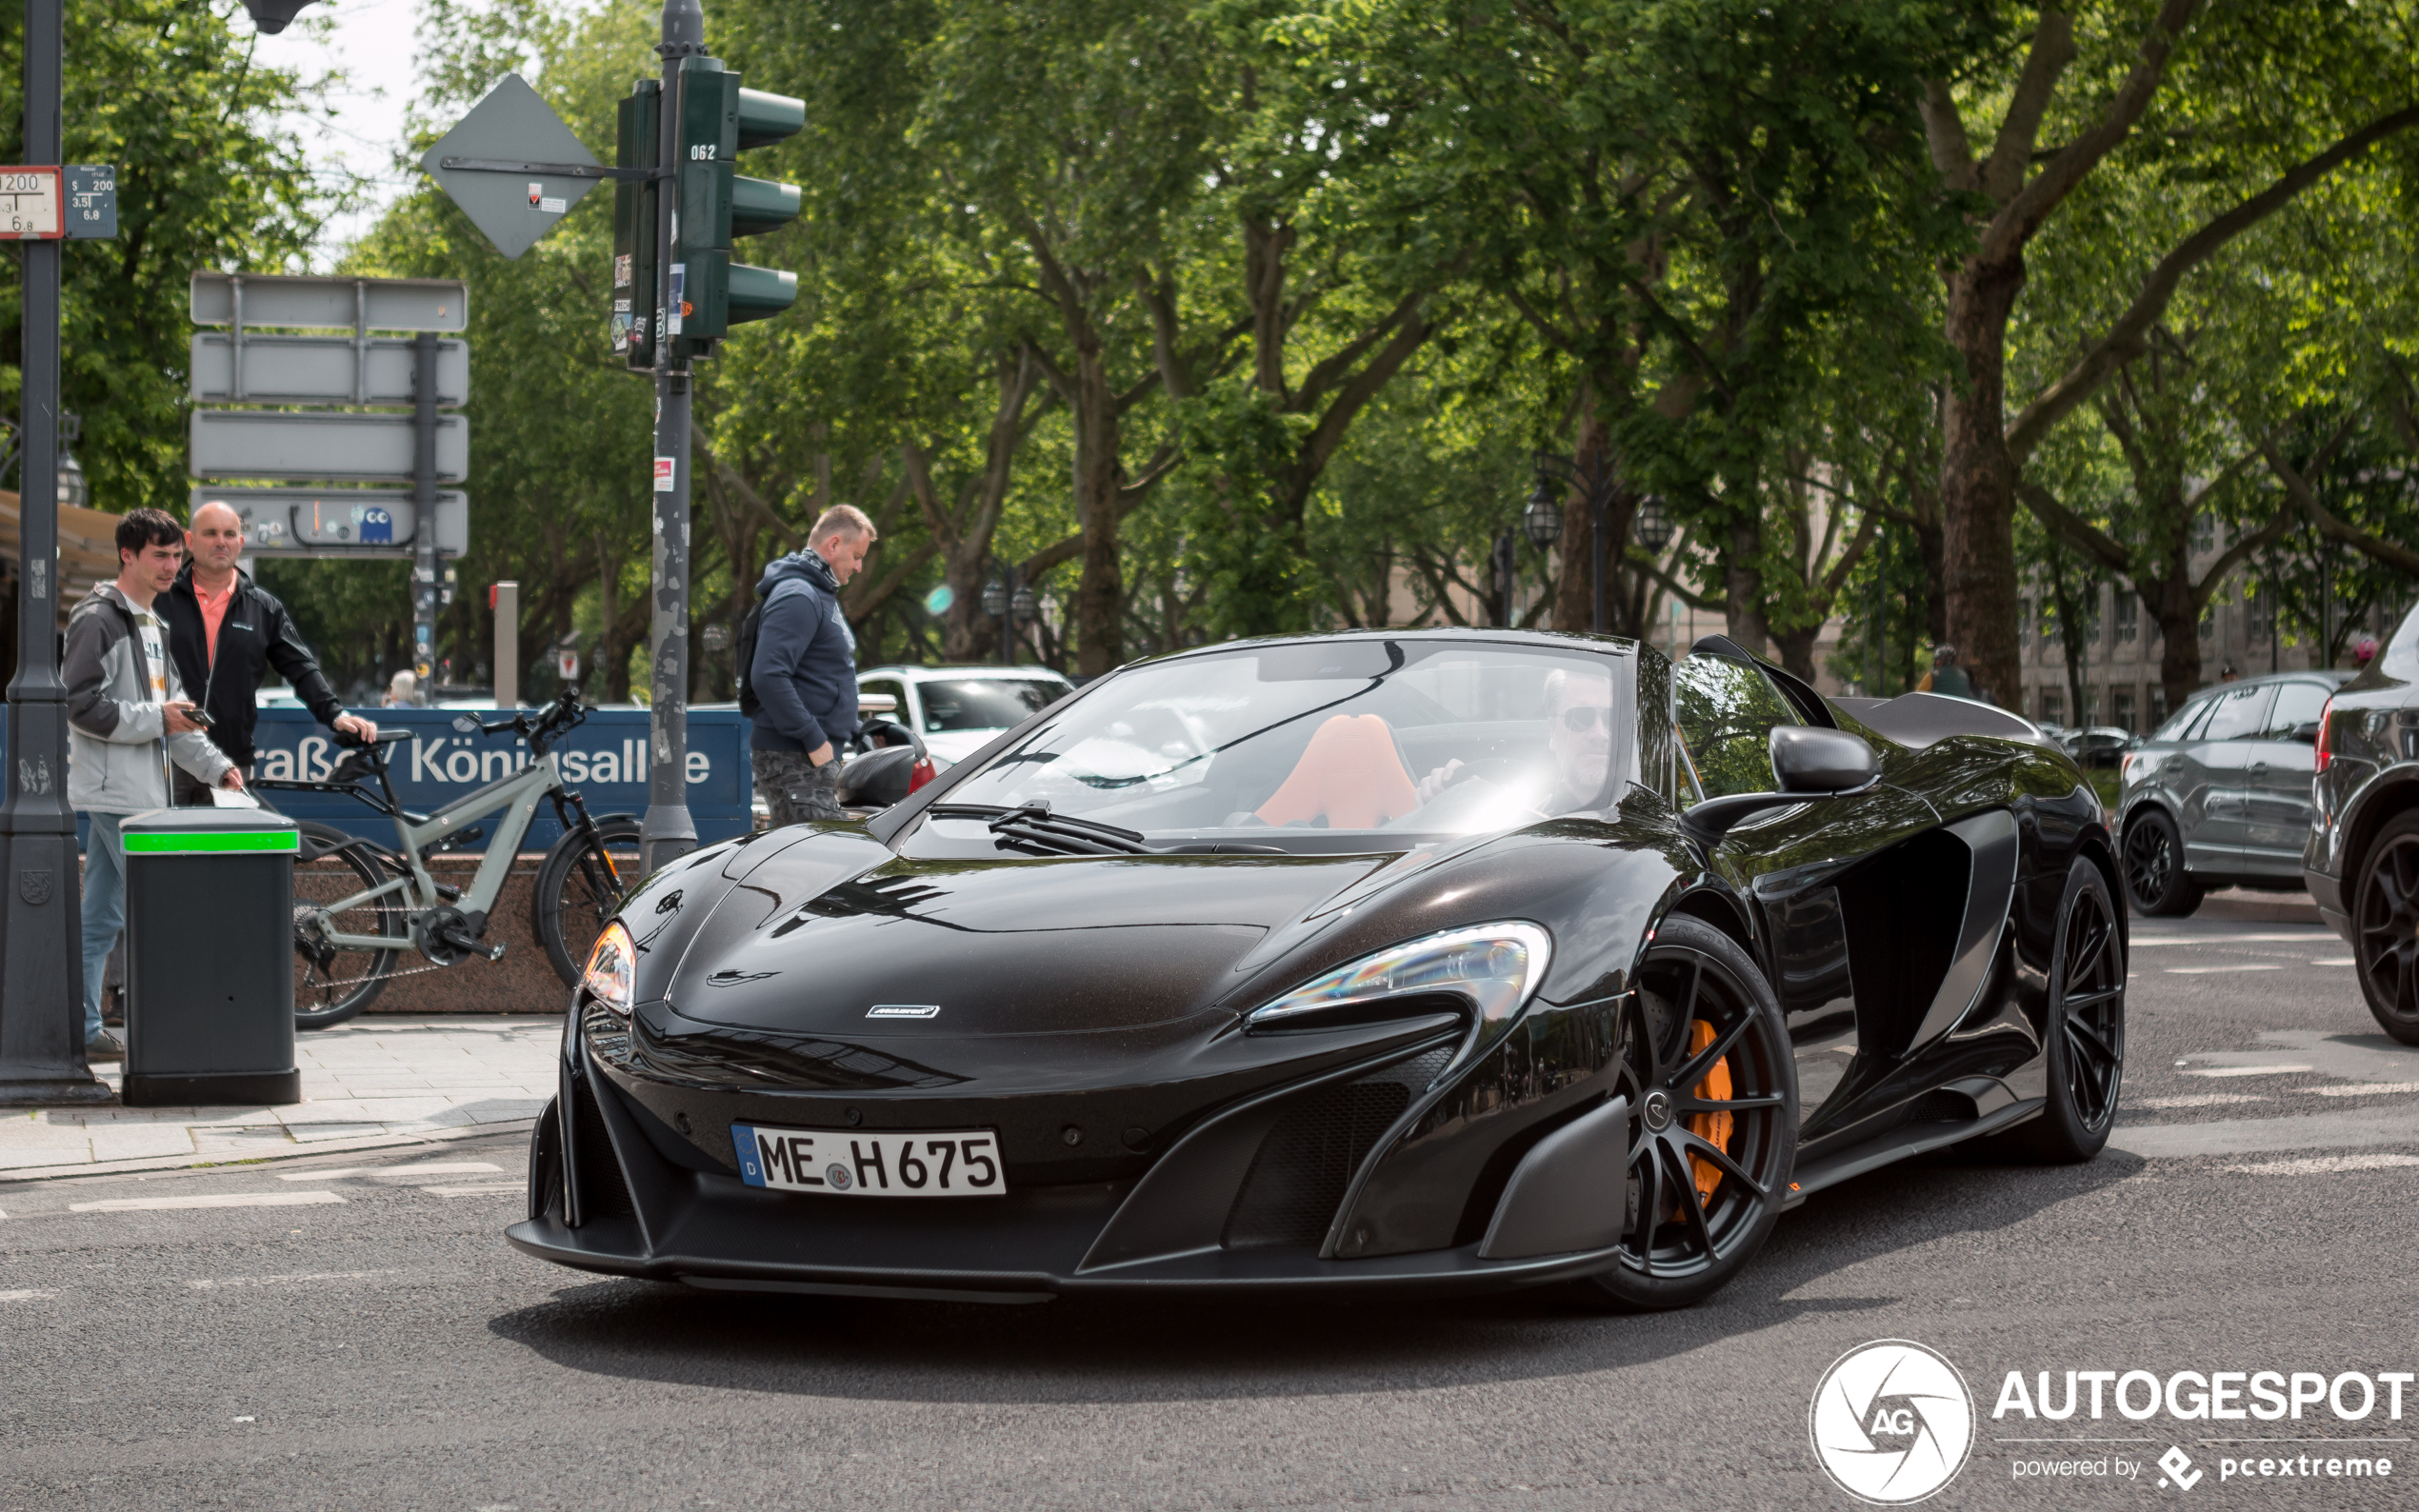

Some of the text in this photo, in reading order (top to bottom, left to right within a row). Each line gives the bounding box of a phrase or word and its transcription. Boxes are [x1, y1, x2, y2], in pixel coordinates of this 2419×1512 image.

[690, 144, 716, 160] 062
[71, 180, 113, 191] S 200
[71, 197, 89, 209] 3.5
[83, 209, 100, 220] 6.8
[11, 215, 33, 231] 6.8
[411, 738, 711, 784] Könisalle
[746, 1161, 756, 1176] D
[758, 1134, 825, 1185] ME
[850, 1141, 889, 1188] H
[899, 1139, 996, 1189] 675
